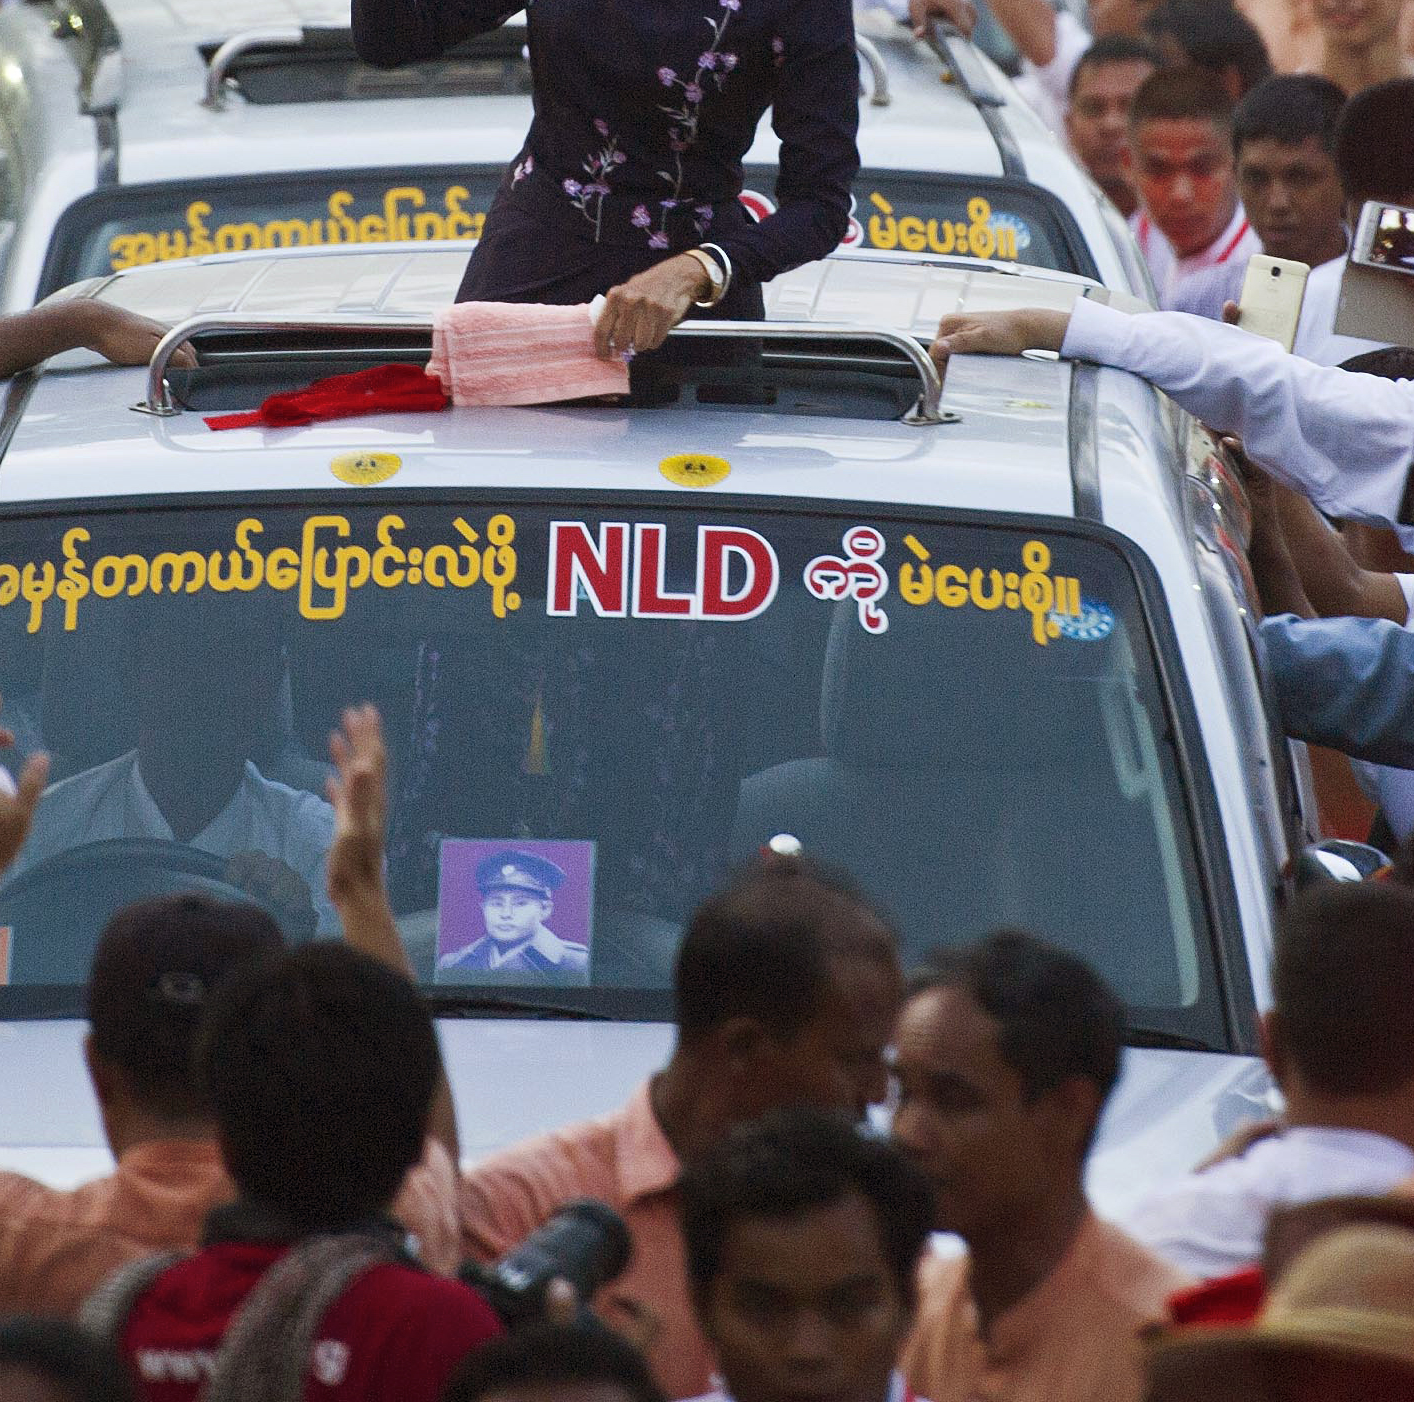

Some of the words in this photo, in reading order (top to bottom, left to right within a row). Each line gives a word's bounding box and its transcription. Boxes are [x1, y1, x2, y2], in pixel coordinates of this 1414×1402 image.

[546, 520, 780, 623] NLD
[803, 524, 890, 636] ကို
[897, 534, 1081, 646] မဲပေးစို့။
